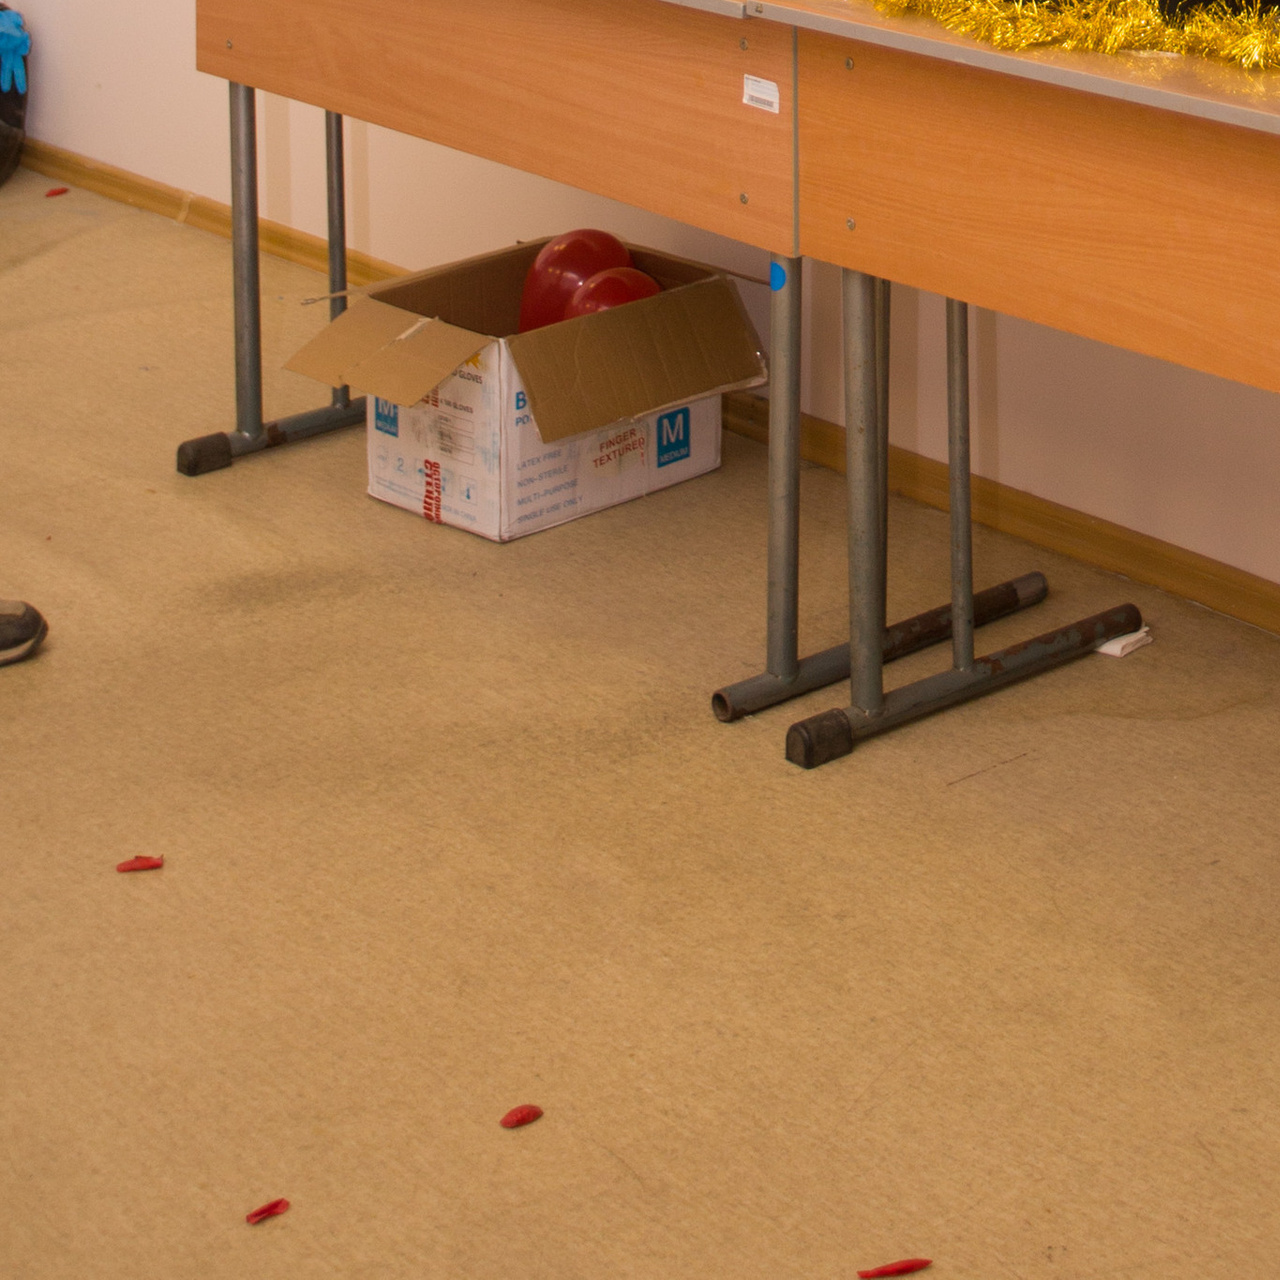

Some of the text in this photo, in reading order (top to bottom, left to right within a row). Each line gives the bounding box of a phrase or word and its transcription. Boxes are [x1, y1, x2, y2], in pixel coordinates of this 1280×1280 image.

[459, 369, 483, 384] GLOVES
[600, 428, 636, 452] FINGER
[663, 413, 683, 446] M
[517, 449, 562, 471] LATEX FREE
[593, 437, 645, 468] TEXTURED
[517, 465, 568, 488] NON-STERILE
[517, 478, 578, 506] MULTI-PURPOSE
[517, 509, 544, 524] SINGLE
[563, 495, 583, 508] ONLY
